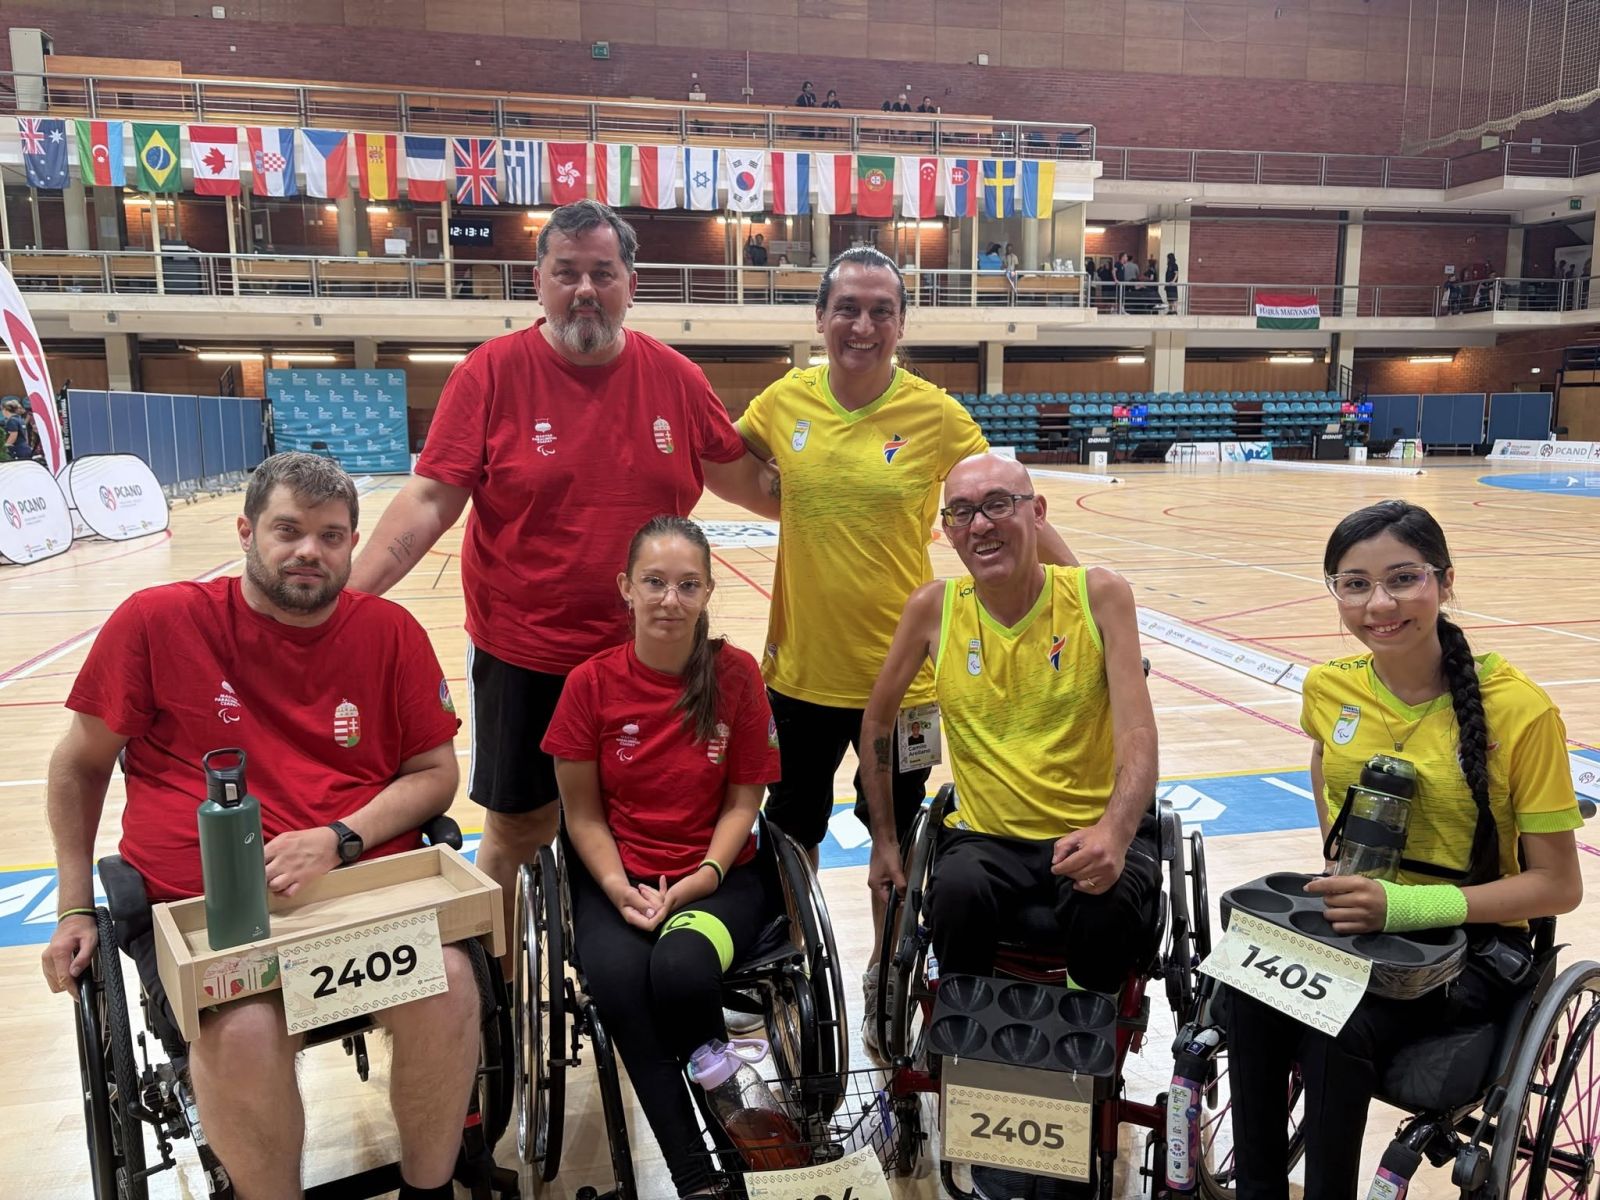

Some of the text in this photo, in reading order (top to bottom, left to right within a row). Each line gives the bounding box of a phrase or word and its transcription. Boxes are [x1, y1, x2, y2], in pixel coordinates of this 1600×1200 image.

[450, 226, 490, 238] 12:13:12
[1098, 454, 1104, 463] 3
[1555, 447, 1587, 456] PCAND
[113, 484, 143, 498] PCAND
[18, 496, 47, 515] PCAND
[309, 944, 418, 999] 2409
[1240, 944, 1333, 1001] 1405
[970, 1112, 1065, 1150] 2405
